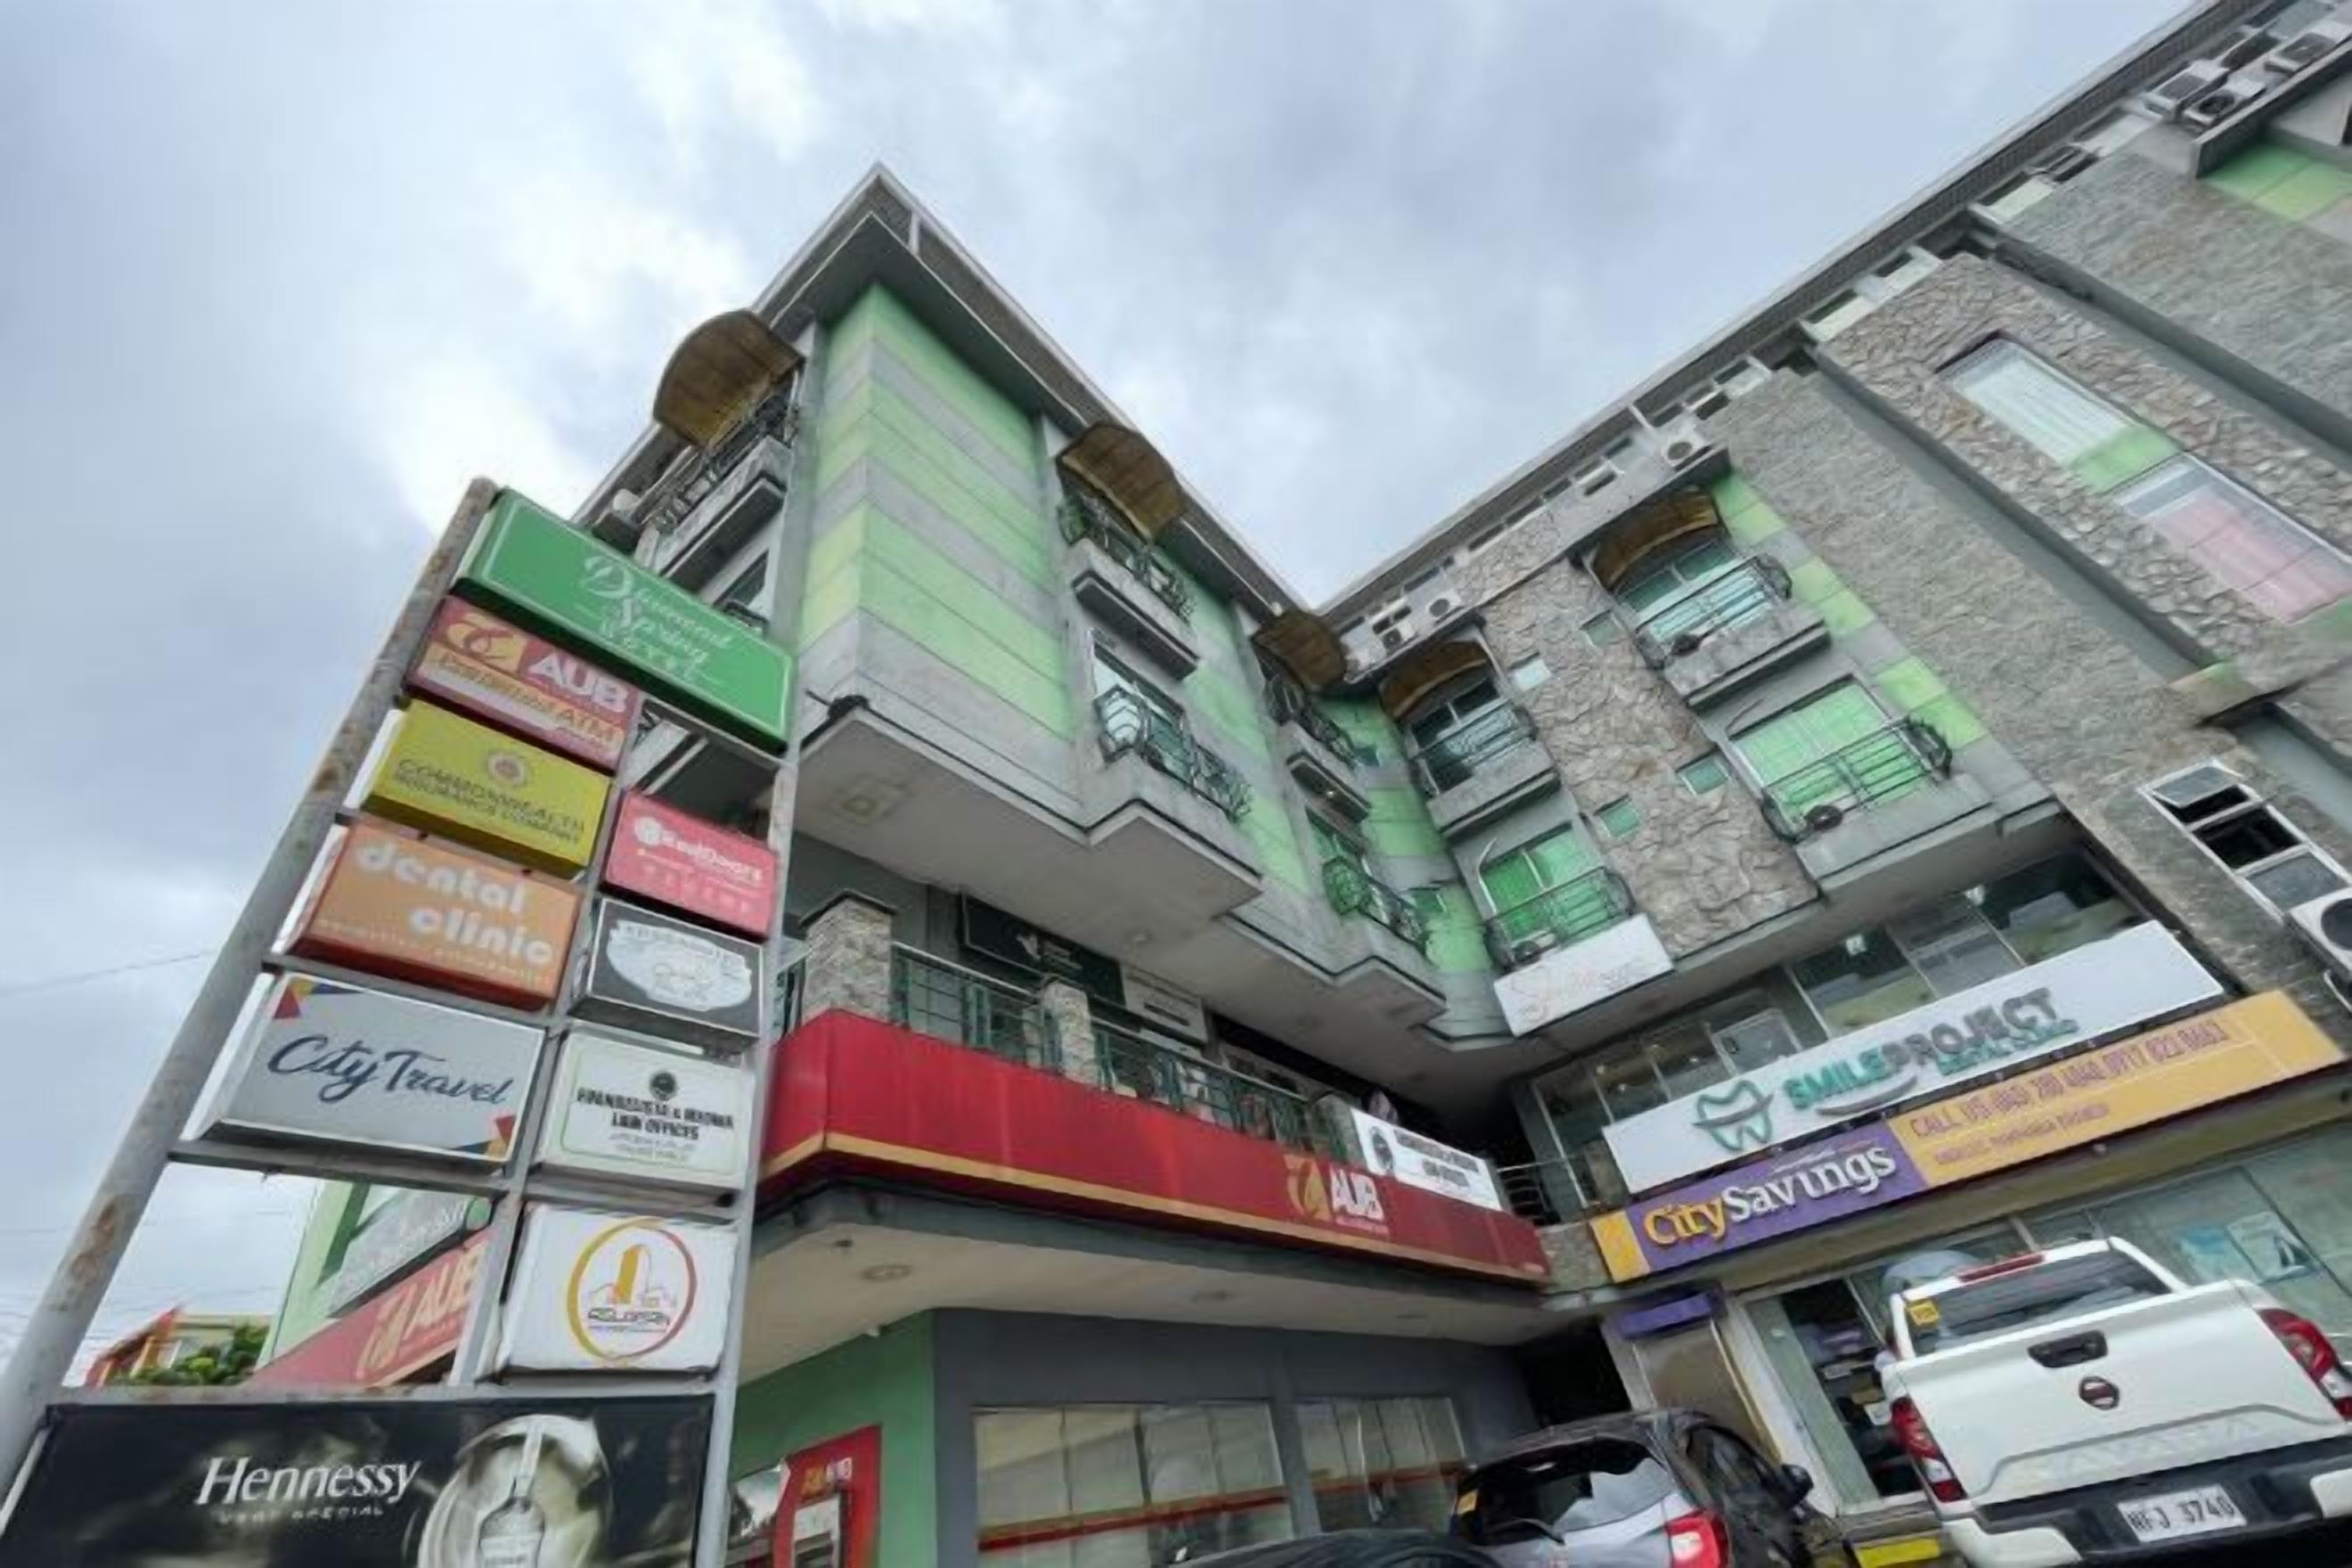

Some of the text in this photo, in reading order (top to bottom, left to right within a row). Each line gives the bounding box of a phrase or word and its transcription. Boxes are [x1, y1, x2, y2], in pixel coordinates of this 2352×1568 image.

[527, 653, 628, 713] AUB
[356, 842, 527, 913] dental
[410, 907, 553, 965] clinic
[267, 1034, 514, 1105] City Travel
[1328, 1160, 1384, 1221] AUB
[194, 1456, 422, 1505] Hennessy
